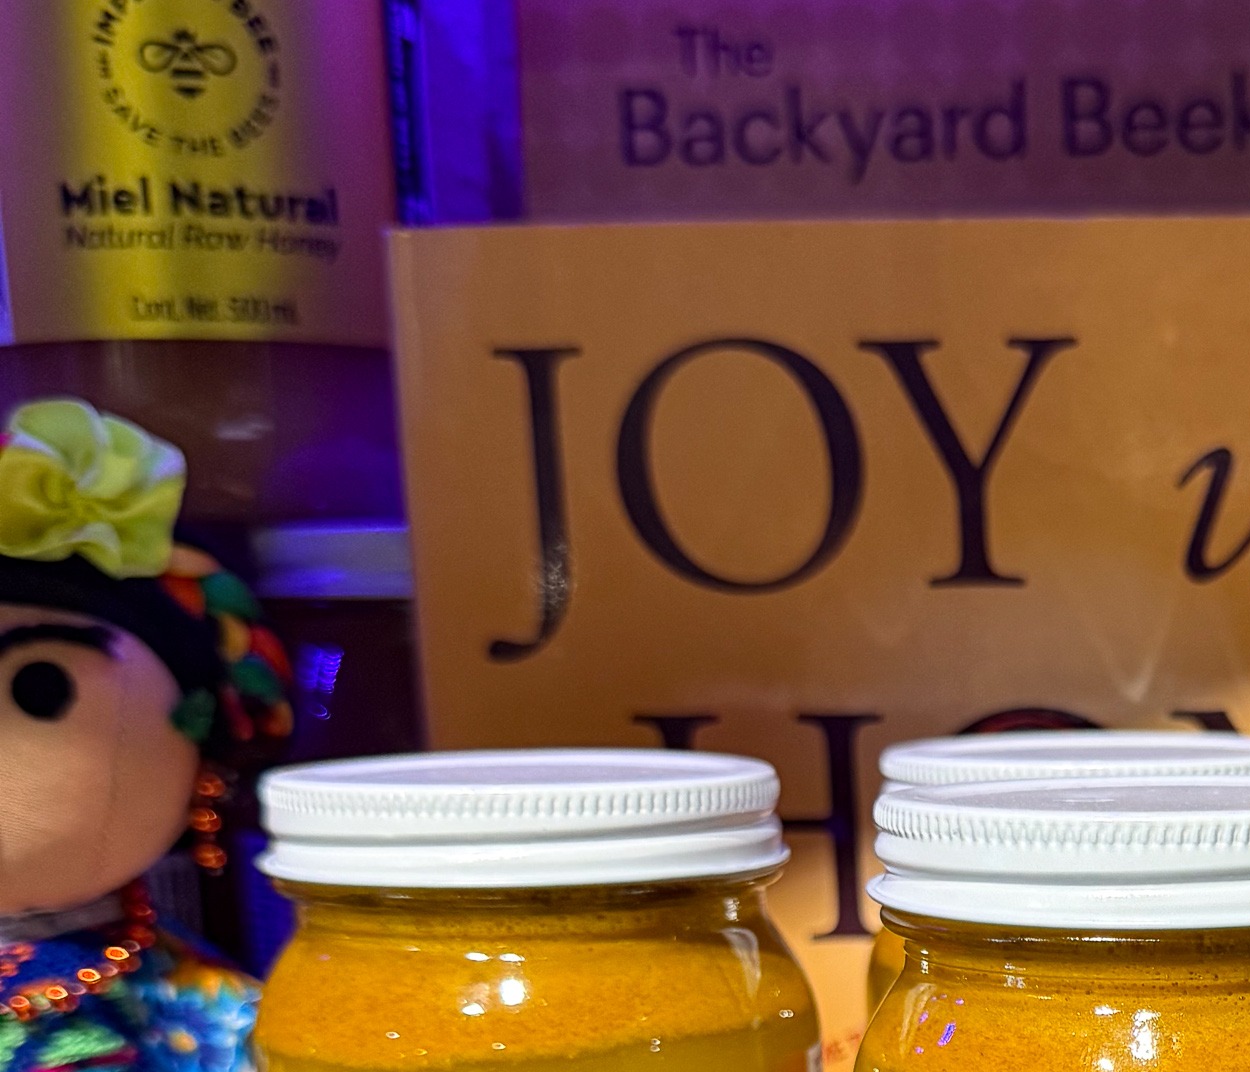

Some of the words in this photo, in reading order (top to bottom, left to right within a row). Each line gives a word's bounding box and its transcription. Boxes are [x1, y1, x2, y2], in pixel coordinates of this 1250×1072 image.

[674, 25, 773, 78] The
[619, 77, 1028, 185] Backyard
[60, 175, 151, 216] Miel
[168, 179, 339, 226] Natural
[64, 224, 174, 249] Natural
[487, 337, 1079, 663] JOY
